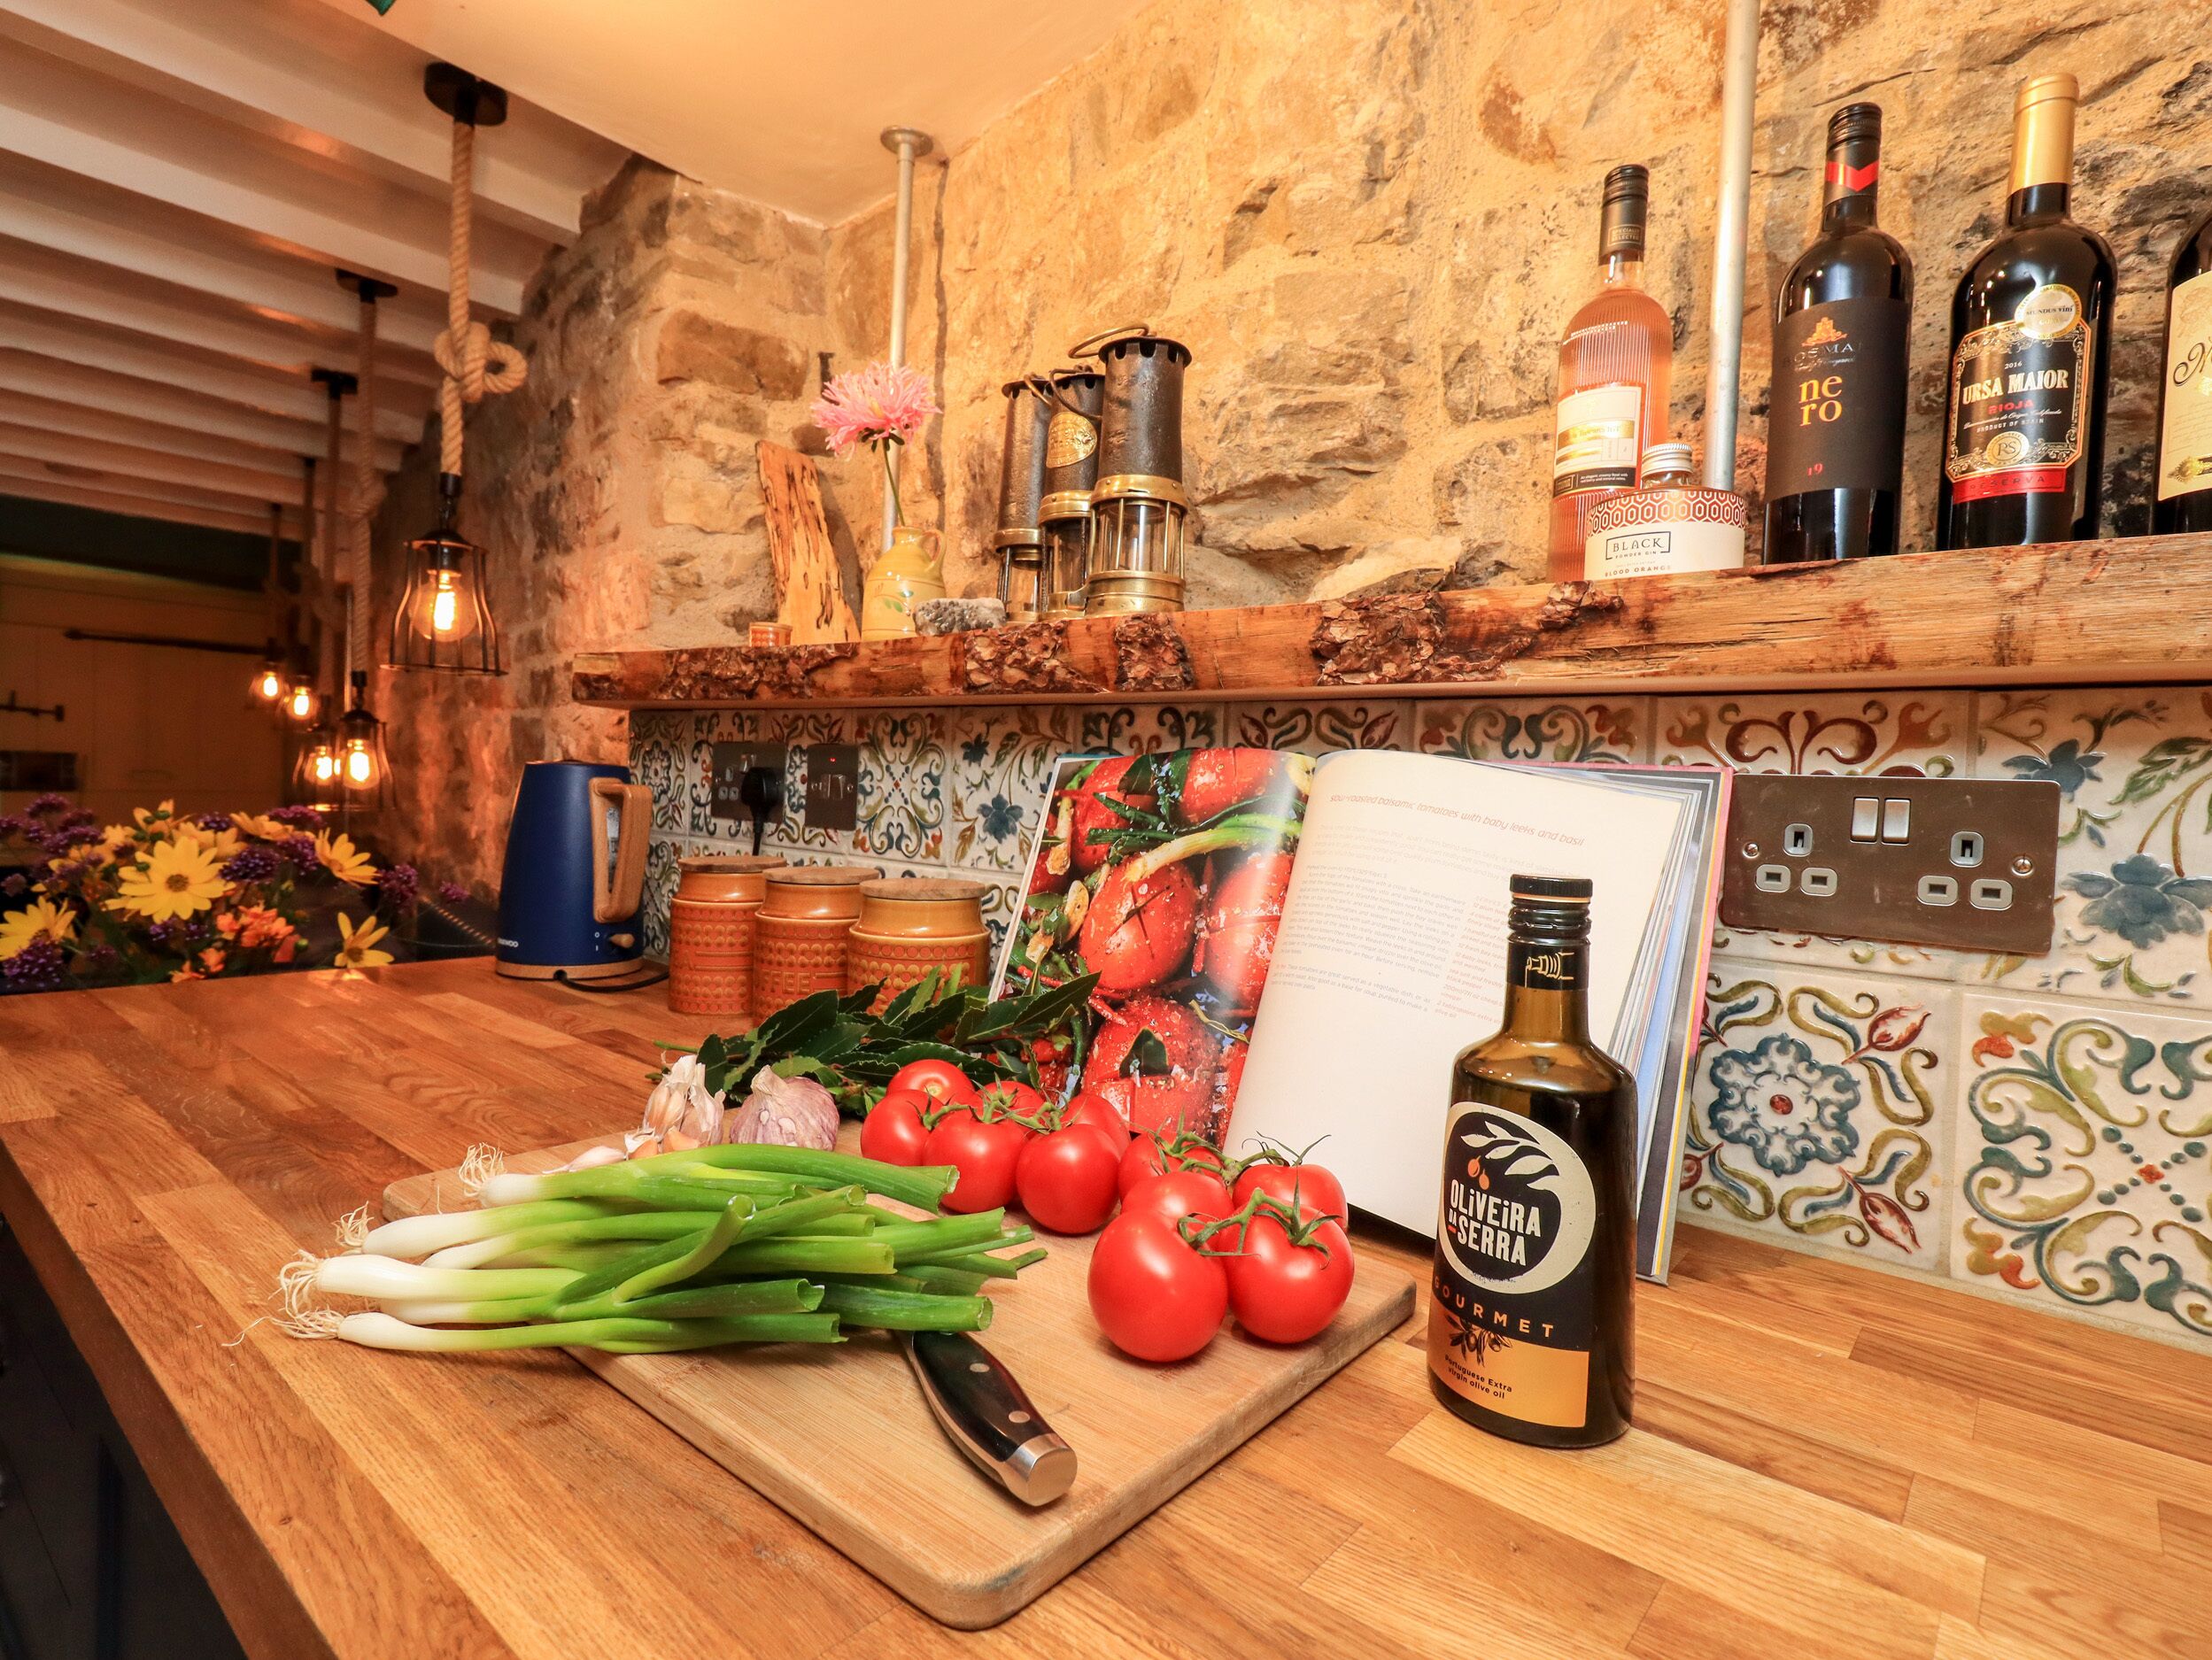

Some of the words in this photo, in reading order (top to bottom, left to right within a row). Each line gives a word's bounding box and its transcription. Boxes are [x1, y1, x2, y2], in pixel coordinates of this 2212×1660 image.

[1798, 375, 1843, 404] ne
[1962, 377, 2003, 405] URSA
[2007, 369, 2069, 394] MAIOR
[1799, 399, 1843, 427] ro
[1988, 399, 2034, 414] RIOJA
[1976, 422, 2007, 433] PRODUCT
[1806, 463, 1823, 476] 19
[1969, 475, 2046, 490] RESERVA
[1613, 538, 1664, 552] BLACK
[1605, 568, 1629, 577] BLOOD
[1377, 796, 1415, 810] balsamic
[1416, 802, 1458, 819] tomatoes
[1460, 811, 1481, 822] with
[1482, 815, 1509, 830] baby
[1510, 822, 1535, 836] leeks
[1537, 828, 1559, 840] and
[1559, 833, 1585, 847] basil
[1449, 1208, 1458, 1227] DA
[1458, 1217, 1527, 1266] SERRA
[1434, 1275, 1554, 1339] GOURMET
[1444, 1355, 1485, 1384] Portuguese
[1488, 1378, 1512, 1393] Extra
[1448, 1367, 1467, 1384] virgin
[1469, 1379, 1490, 1394] olive
[1493, 1389, 1504, 1400] oil
